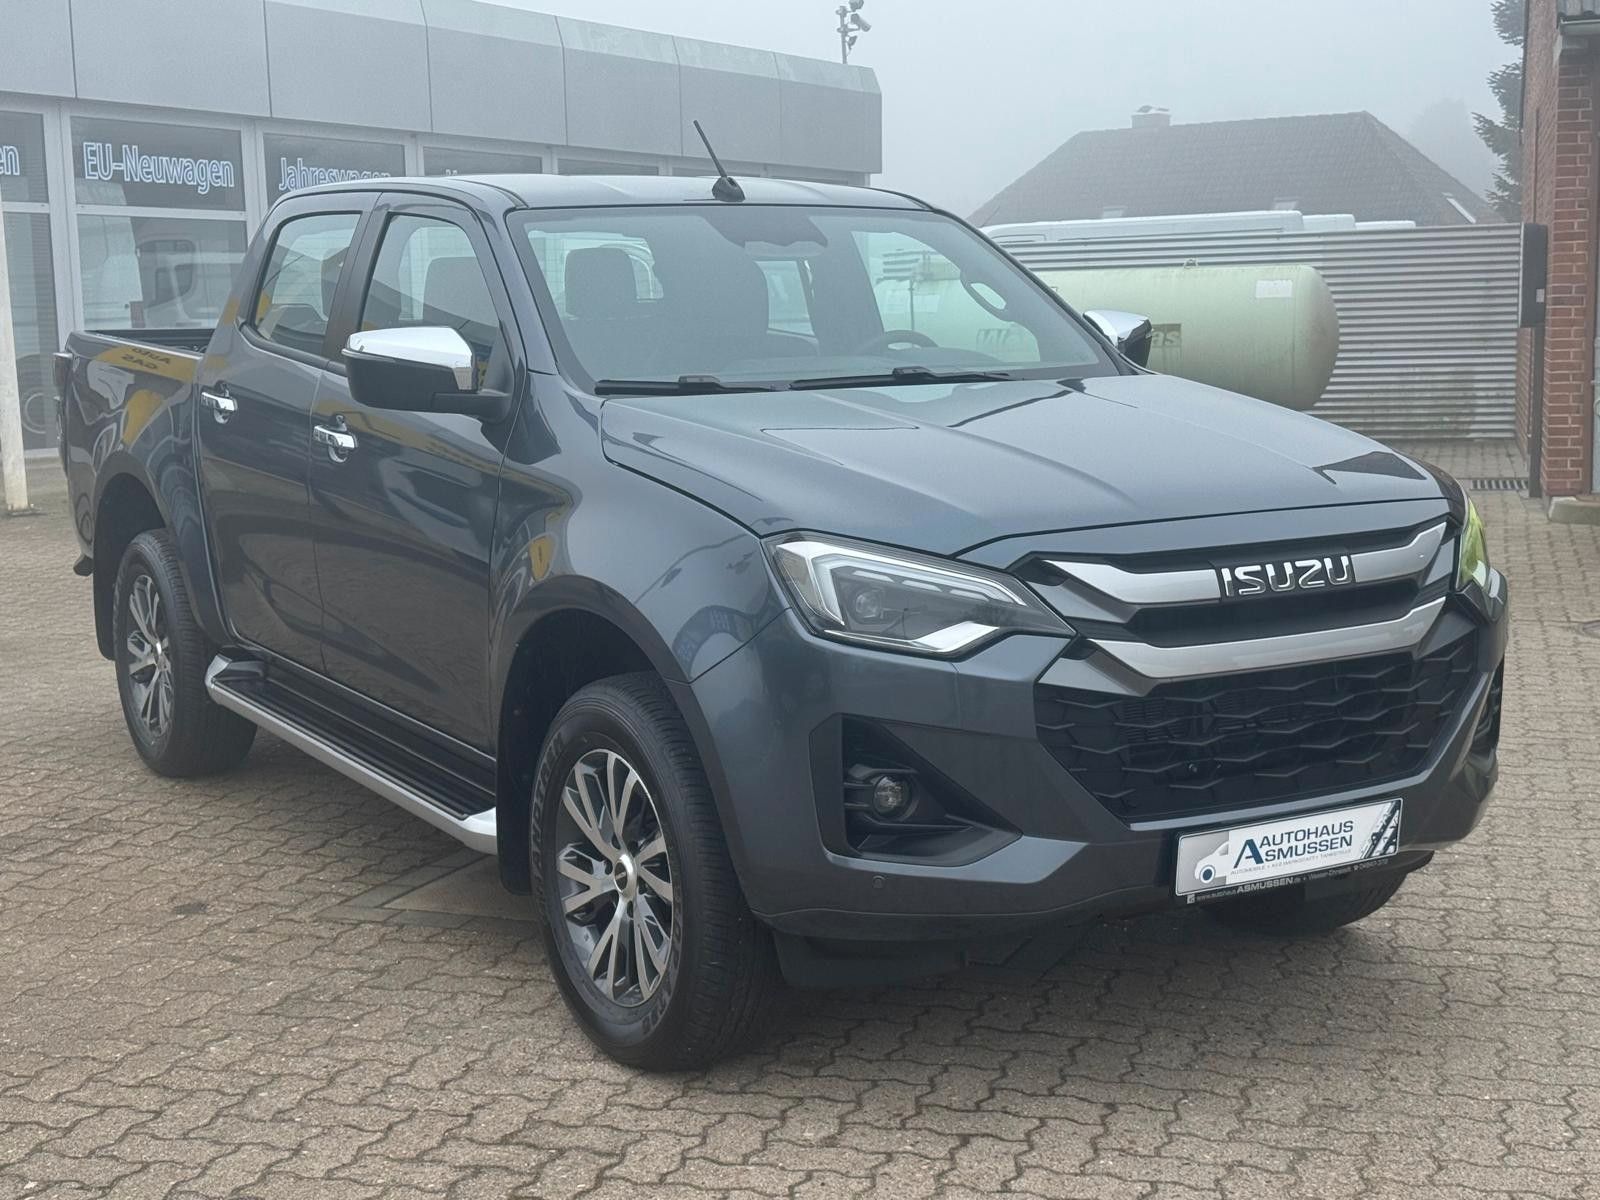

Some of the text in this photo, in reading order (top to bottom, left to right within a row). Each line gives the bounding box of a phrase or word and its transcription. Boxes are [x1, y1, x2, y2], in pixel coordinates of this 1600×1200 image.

[83, 142, 235, 195] EU-Neuwagen
[1221, 556, 1352, 597] ISUZU
[1259, 820, 1354, 849] AUTOHAUS
